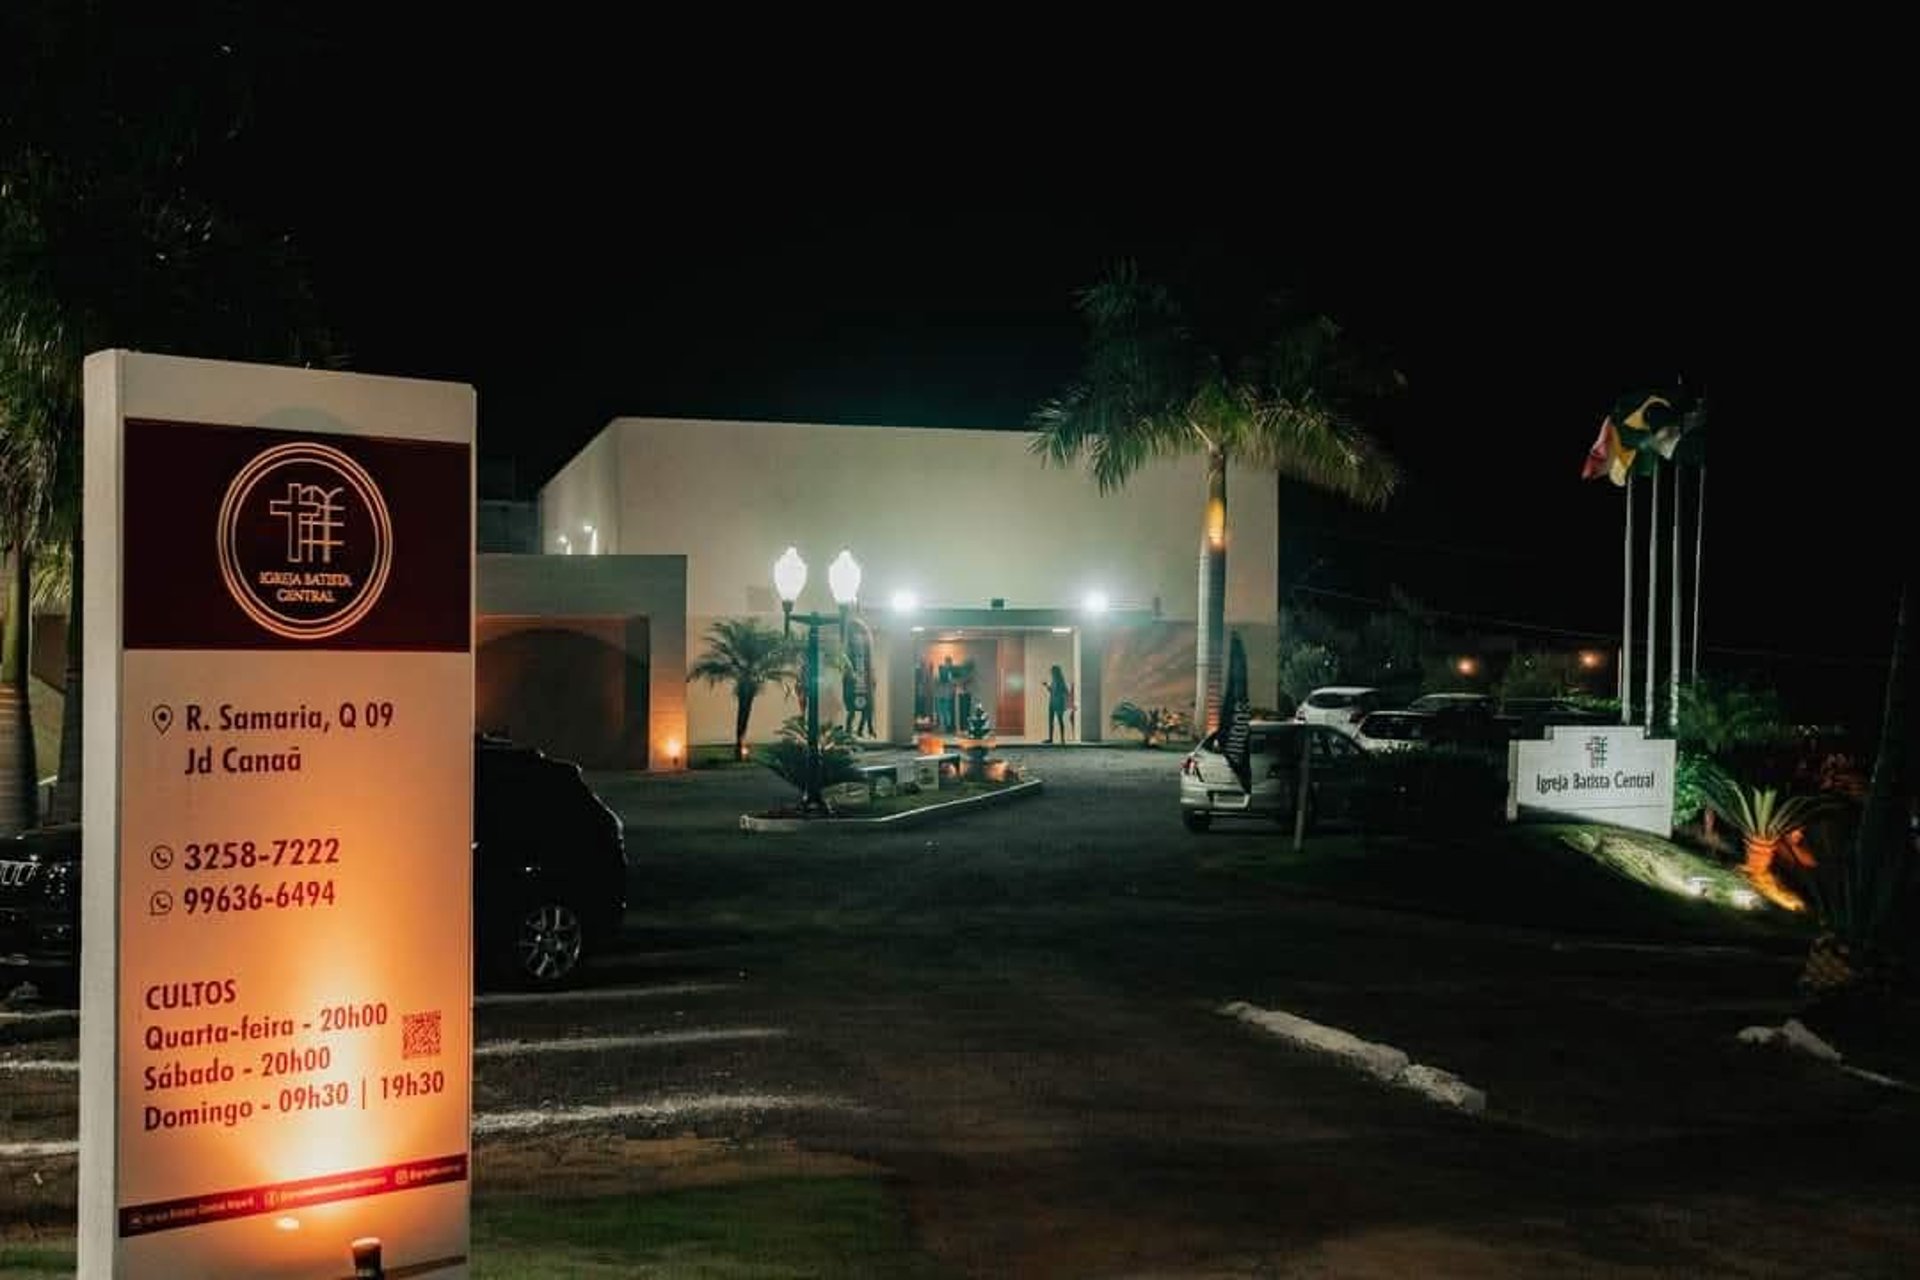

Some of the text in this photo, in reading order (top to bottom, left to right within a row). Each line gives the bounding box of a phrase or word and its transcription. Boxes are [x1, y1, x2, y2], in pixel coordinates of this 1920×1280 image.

[259, 572, 301, 585] IGREJA
[277, 588, 336, 602] CENTRAL
[186, 702, 393, 733] R. Samaria, Q 09
[185, 746, 301, 775] Jd Canaã
[1537, 771, 1655, 794] Igreja Batista Central
[184, 838, 340, 871] 3258-7222
[184, 880, 335, 914] 99636-6494
[146, 979, 236, 1010] CULTOS
[145, 1015, 294, 1051] Quarta-feira
[321, 1003, 388, 1032] 20h00
[144, 1058, 234, 1091] Sábado
[261, 1046, 331, 1077] 20h00
[144, 1098, 253, 1131] Domingo
[279, 1081, 349, 1112] 09h30
[381, 1071, 444, 1100] 19h30
